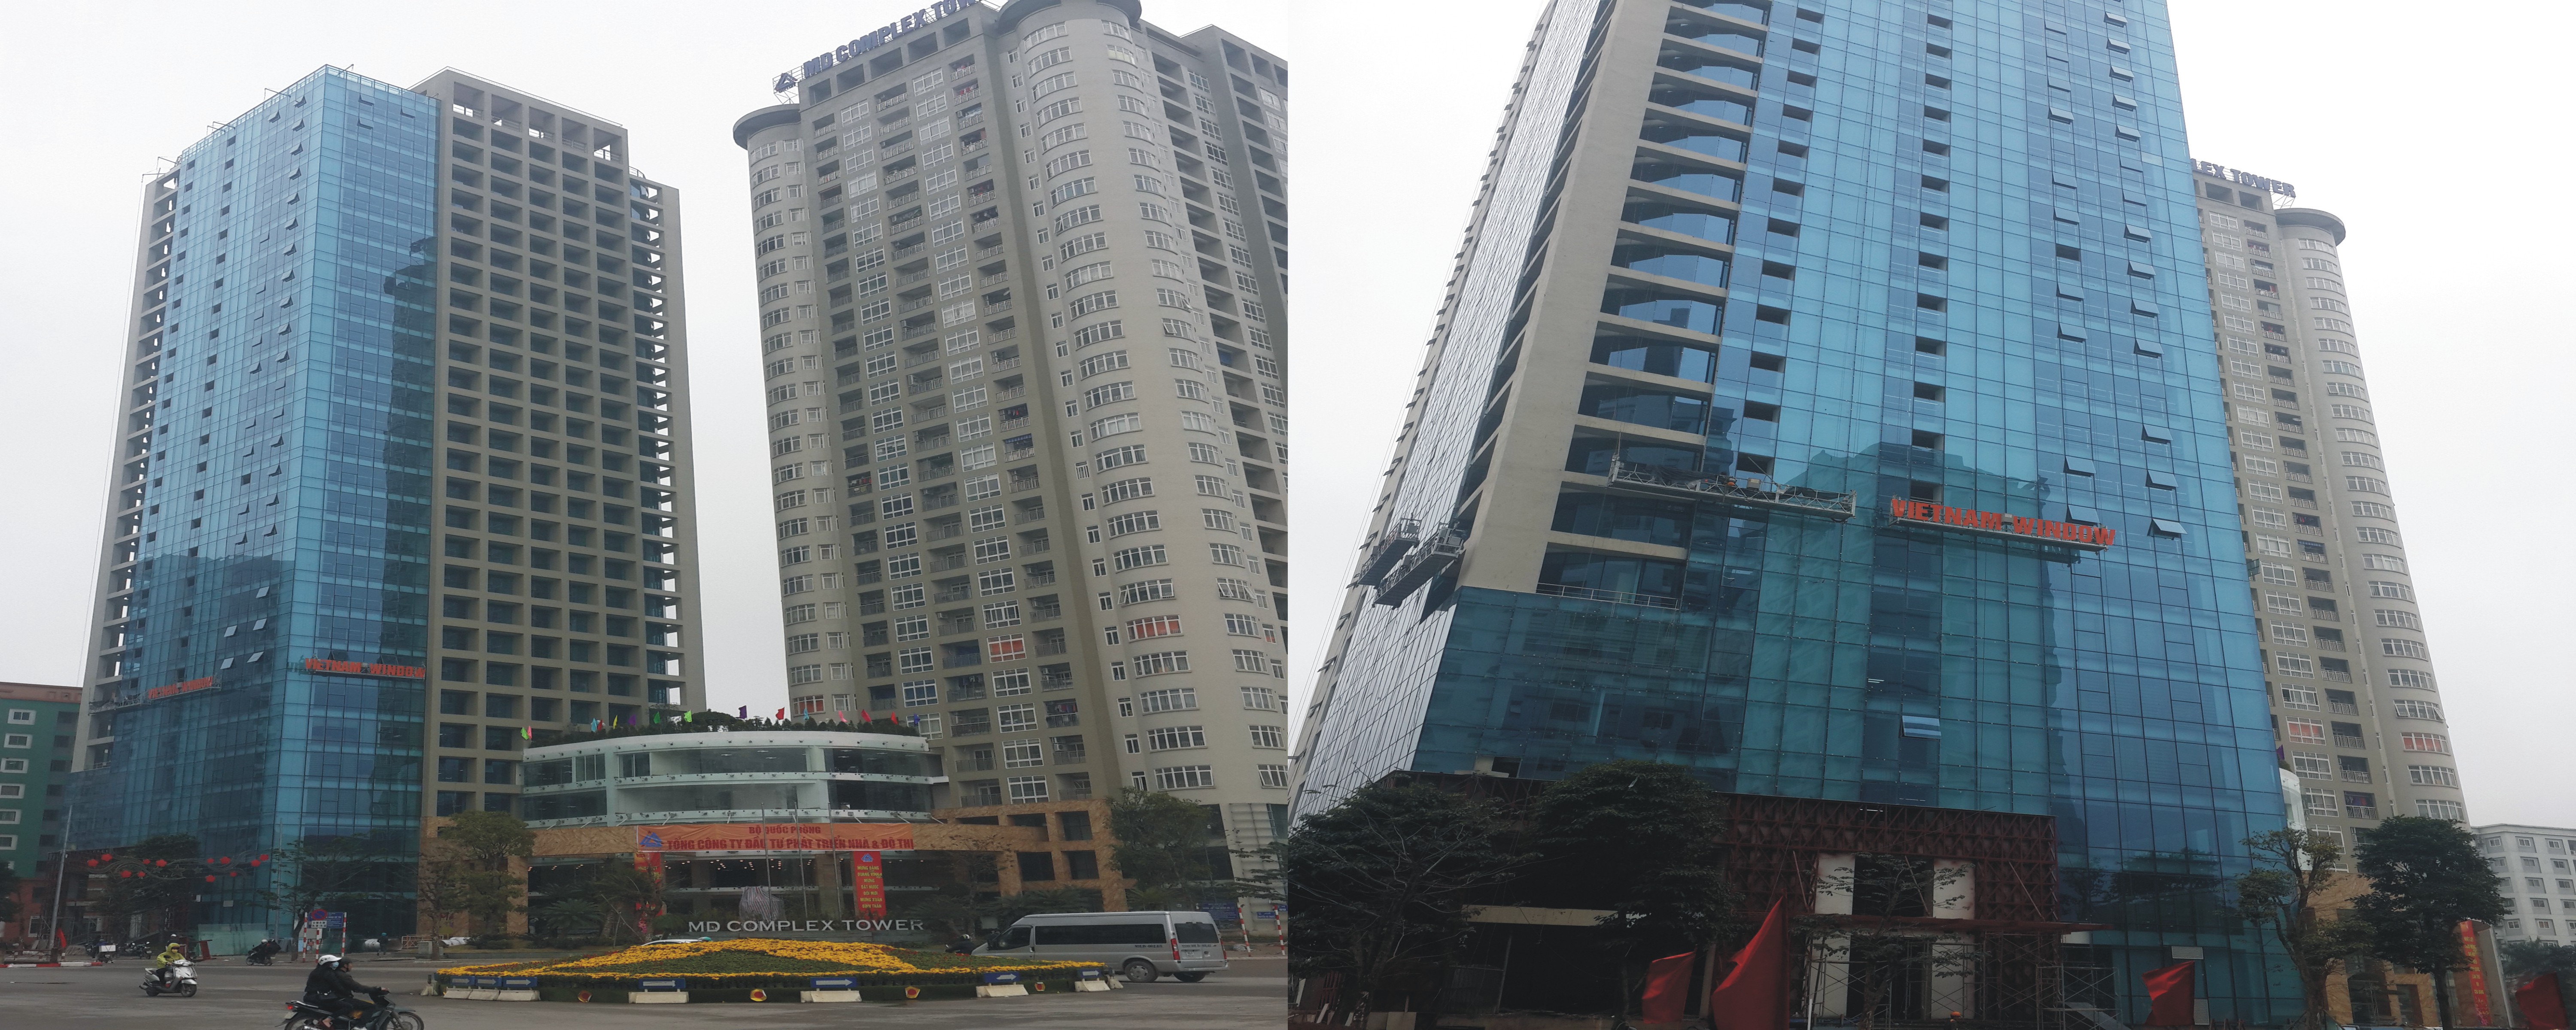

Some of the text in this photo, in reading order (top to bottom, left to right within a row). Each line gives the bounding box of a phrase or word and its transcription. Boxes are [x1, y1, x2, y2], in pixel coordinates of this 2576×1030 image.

[803, 52, 833, 78] MD
[836, 9, 925, 63] COMPLEX
[2230, 169, 2296, 197] TOWER
[1892, 498, 2116, 546] VIETNAM WINDOW
[305, 658, 426, 678] VIETNAM WINDOW
[749, 825, 761, 835] BỘ
[765, 824, 788, 834] QUỐC
[667, 836, 695, 850] TỔNG
[697, 837, 727, 849] CÔNG
[730, 839, 743, 848] TY
[745, 836, 766, 849] ĐẦU
[769, 838, 784, 848] TƯ
[786, 837, 813, 848] PHÁT
[848, 837, 870, 848] NHÀ
[872, 840, 879, 848] &
[880, 837, 895, 848] ĐÔ
[689, 920, 924, 932] MD COMPLEX TOWER
